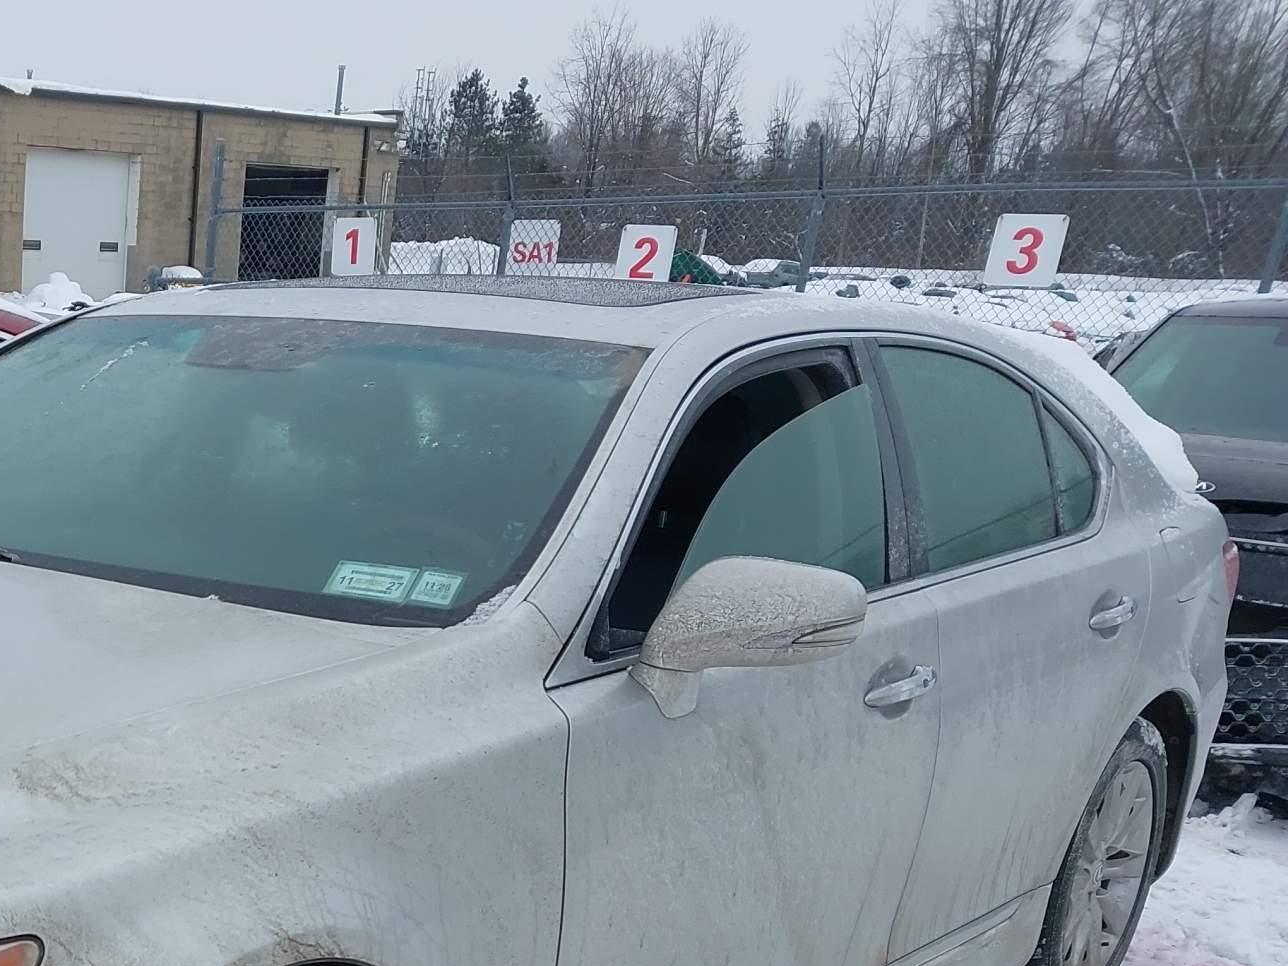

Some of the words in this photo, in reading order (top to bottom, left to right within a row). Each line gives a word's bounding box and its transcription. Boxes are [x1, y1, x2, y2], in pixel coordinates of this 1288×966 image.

[345, 229, 360, 265] 1
[512, 241, 556, 264] SA1
[628, 237, 660, 279] 2
[1006, 227, 1044, 275] 3
[339, 575, 354, 585] 11
[385, 581, 405, 591] 27
